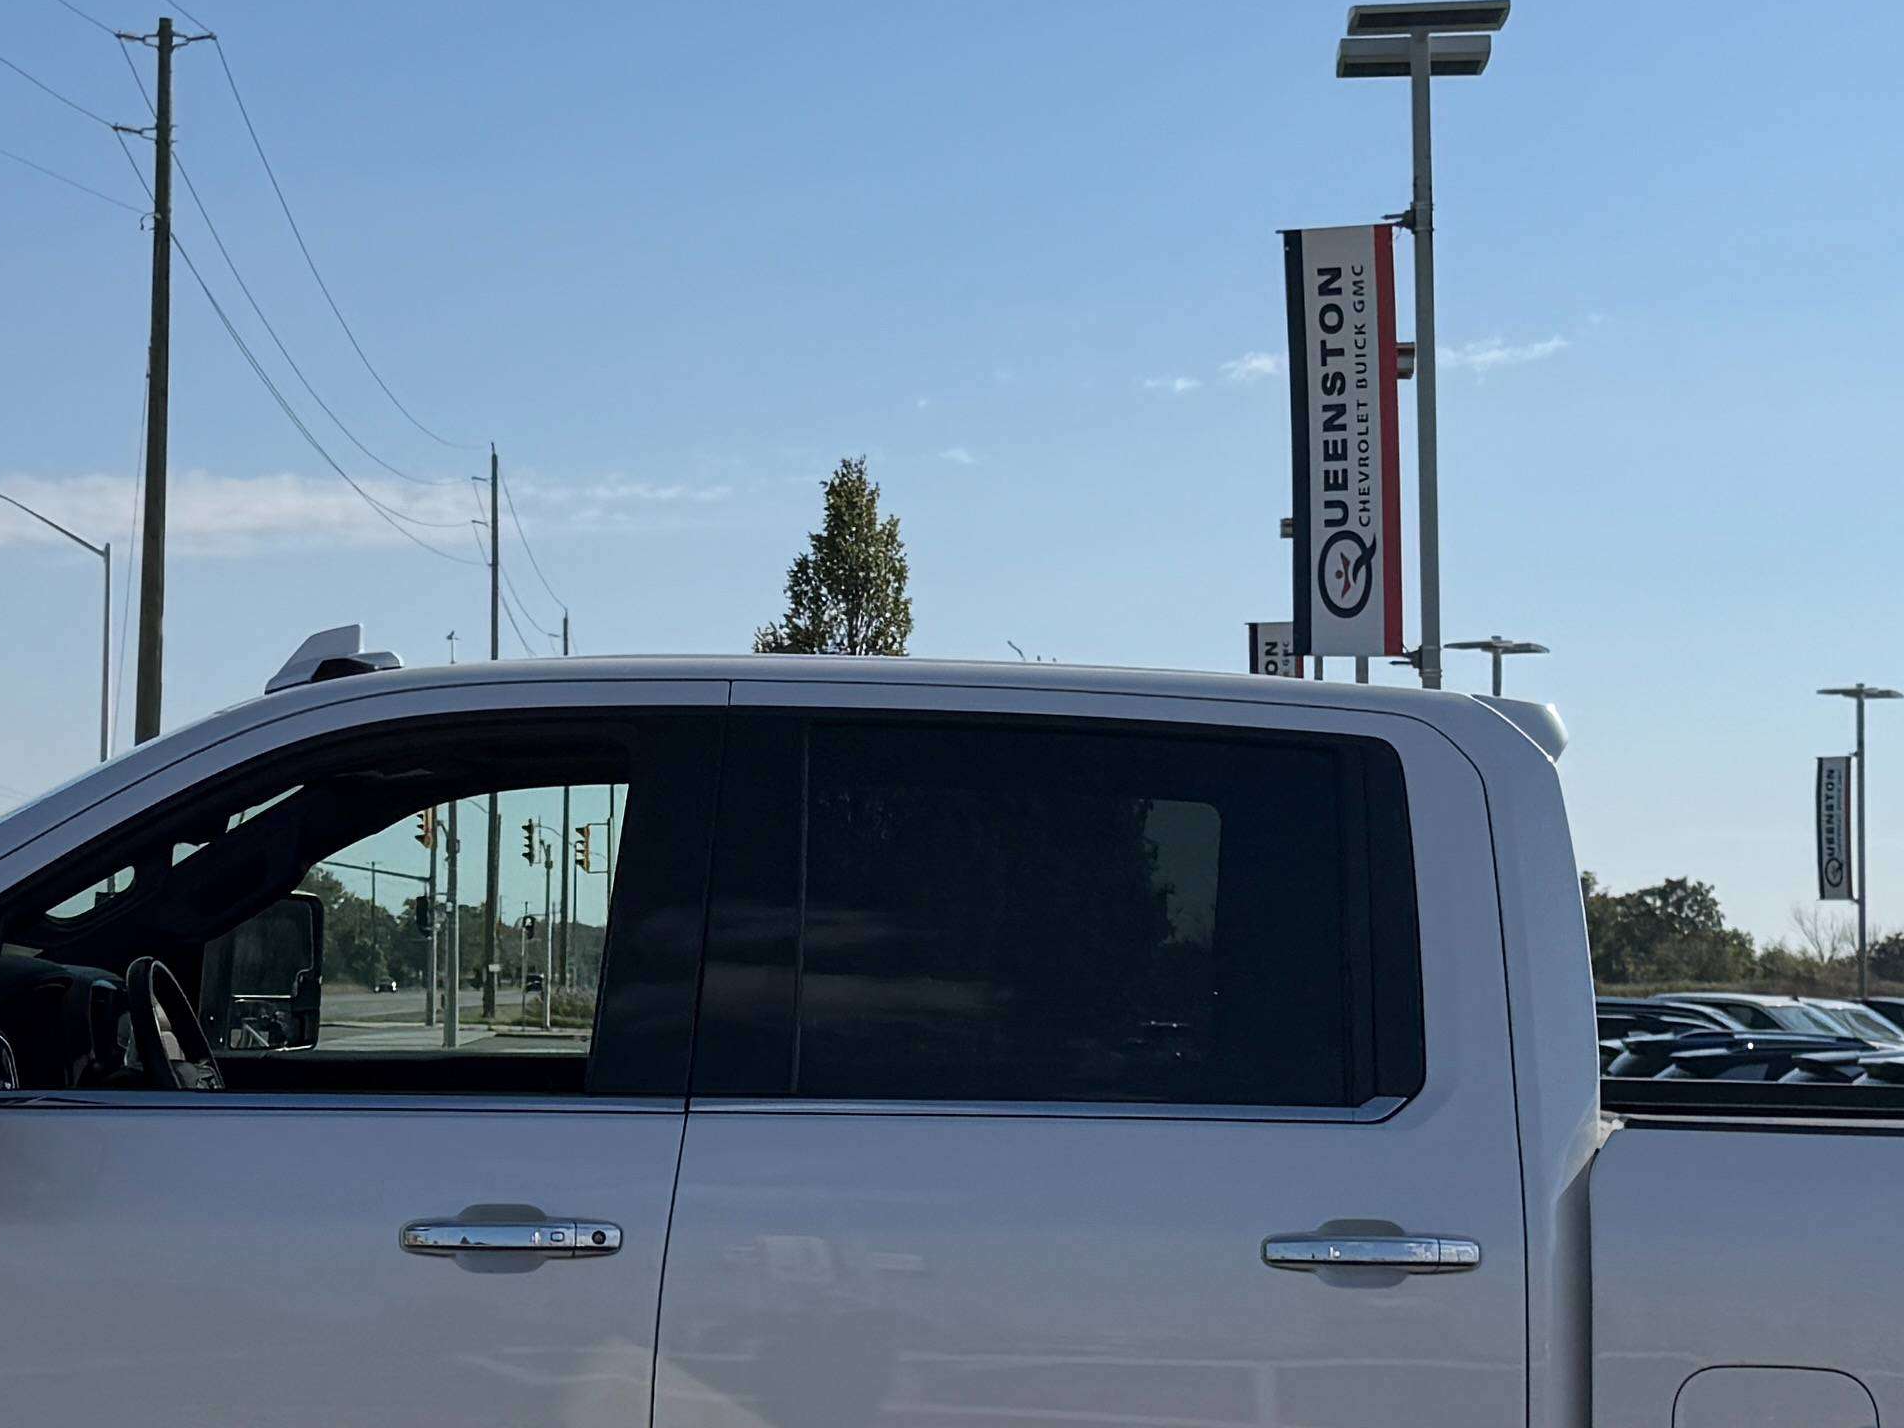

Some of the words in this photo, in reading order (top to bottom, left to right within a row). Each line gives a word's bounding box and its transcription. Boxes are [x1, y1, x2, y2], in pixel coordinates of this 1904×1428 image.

[1352, 264, 1366, 312] GMC
[1352, 323, 1368, 389] BUICK
[1317, 267, 1376, 618] QUEENSTON
[1352, 399, 1371, 527] CHEVROLET
